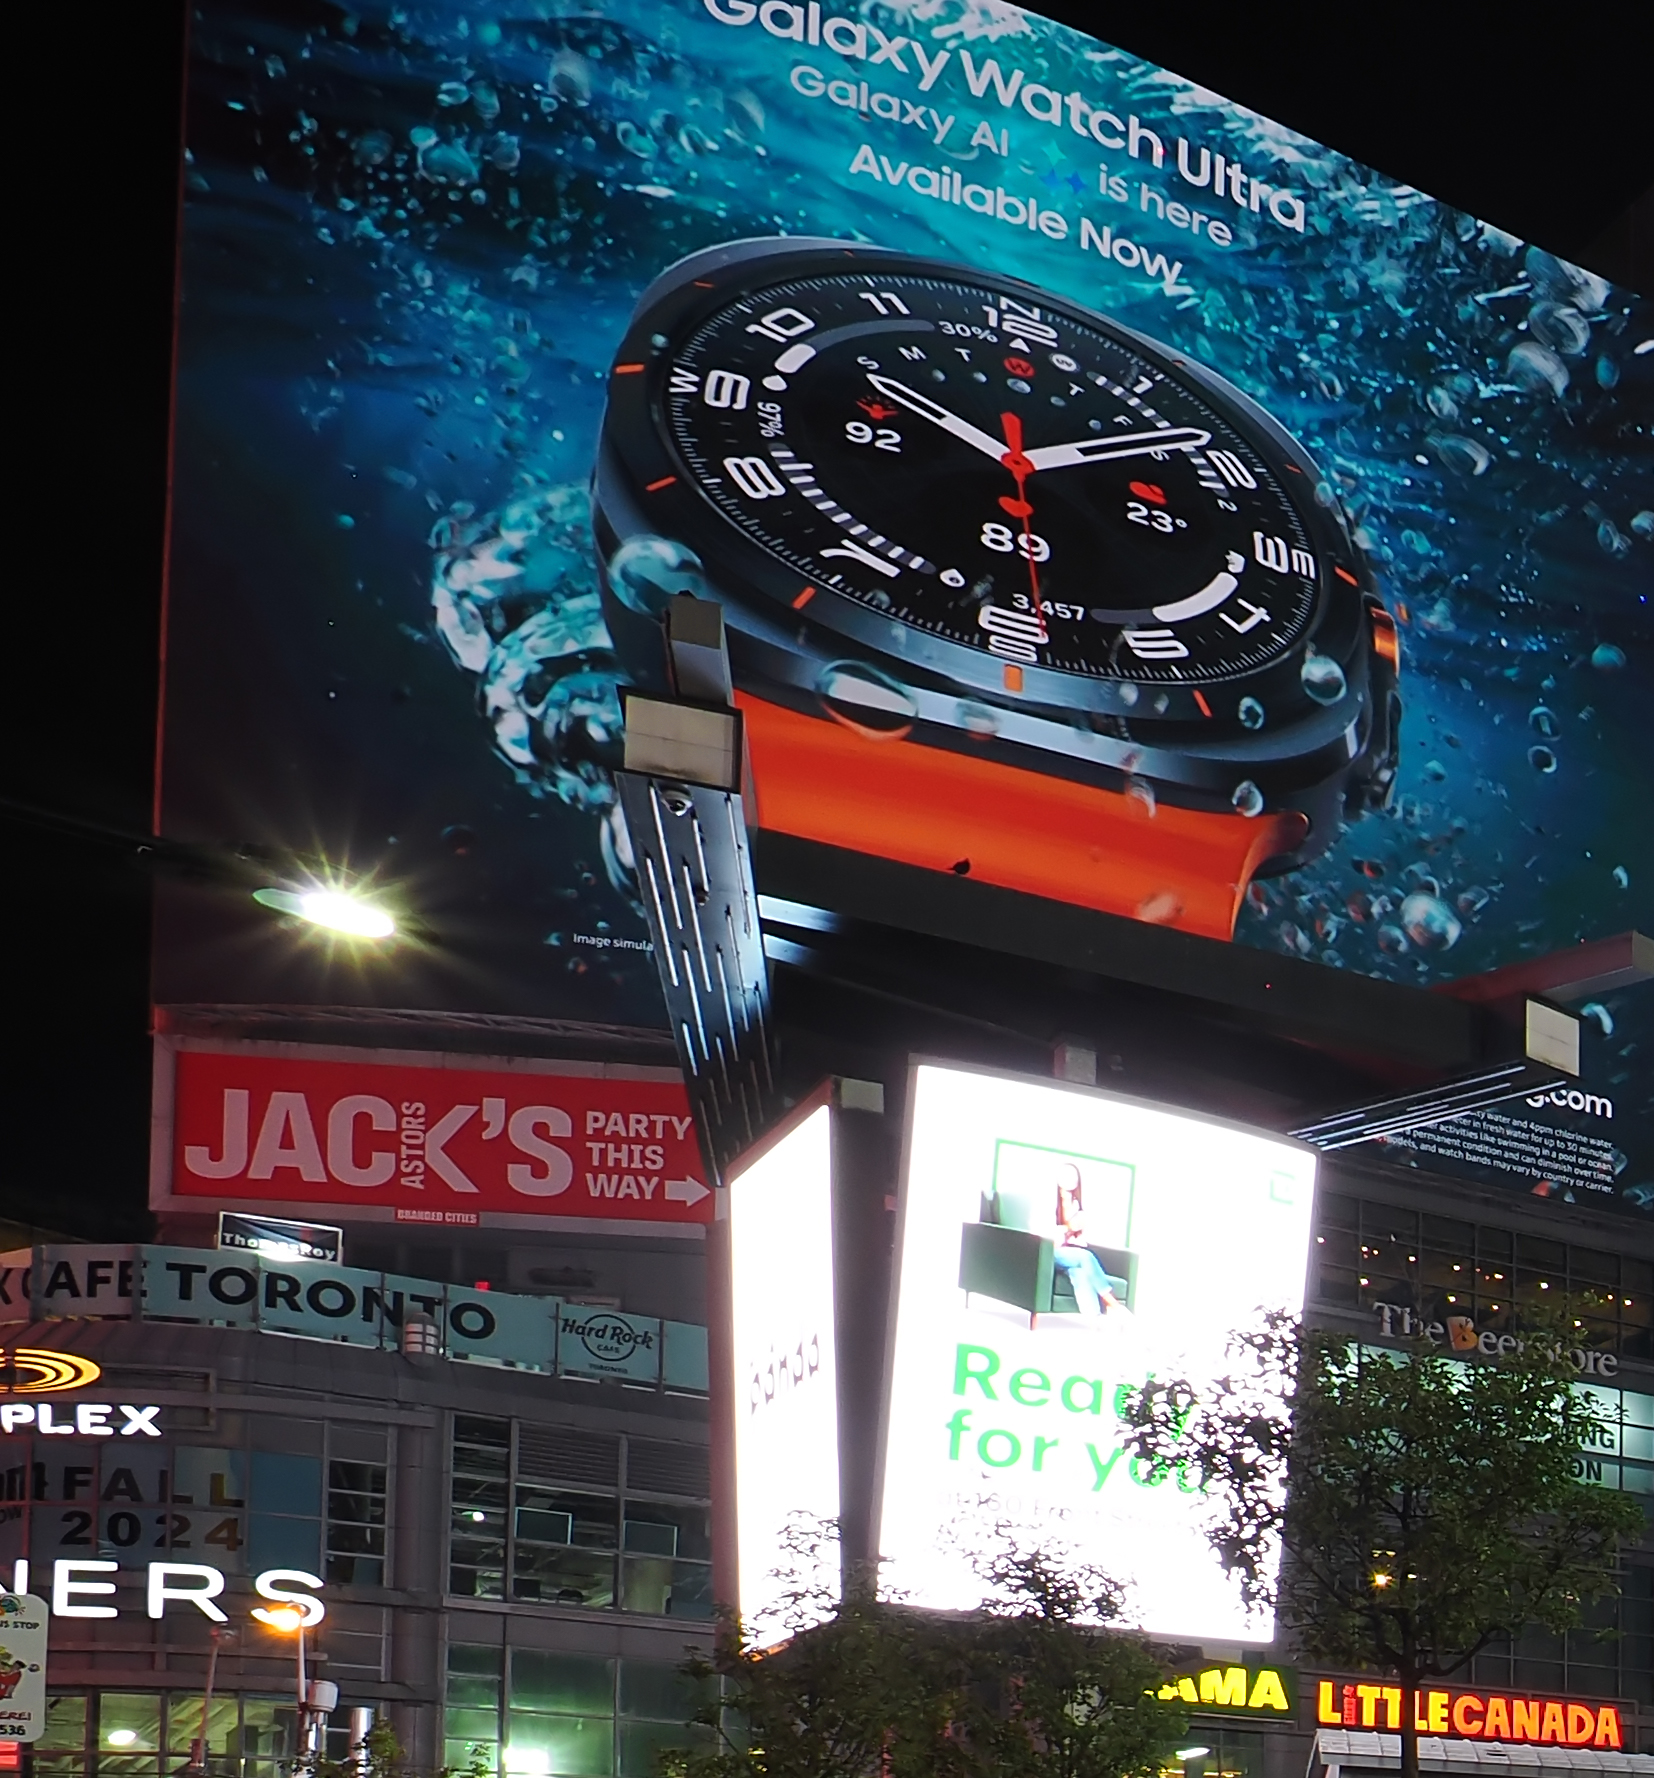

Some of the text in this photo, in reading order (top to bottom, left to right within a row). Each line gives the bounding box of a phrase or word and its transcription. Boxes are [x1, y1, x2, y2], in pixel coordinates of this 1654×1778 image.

[704, 0, 1307, 233] Galaxy Watch Ultra
[790, 65, 1233, 247] Galaxy AI is here
[849, 144, 1186, 286] Available Now
[859, 292, 911, 315] 11
[745, 307, 816, 343] 10
[938, 320, 999, 344] 30%
[844, 420, 902, 453] 92
[980, 523, 1051, 563] 89
[573, 932, 612, 948] Image
[586, 1111, 693, 1140] PARTY
[1505, 1128, 1530, 1141] water
[1554, 1128, 1588, 1144] chlorine
[586, 1141, 664, 1171] THIS
[1412, 1130, 1461, 1147] permanent
[1462, 1140, 1502, 1156] condition
[1420, 1142, 1436, 1153] and
[1437, 1147, 1464, 1160] watch
[1558, 1152, 1576, 1163] pool
[586, 1173, 658, 1200] WAY
[166, 1261, 496, 1340] TORONTO
[561, 1318, 653, 1350] Hard Rock
[1373, 1301, 1445, 1346] The
[945, 1408, 1060, 1472] for
[62, 1466, 244, 1508] FALL
[60, 1510, 244, 1551] 2024
[1453, 1694, 1623, 1749] CANADA
